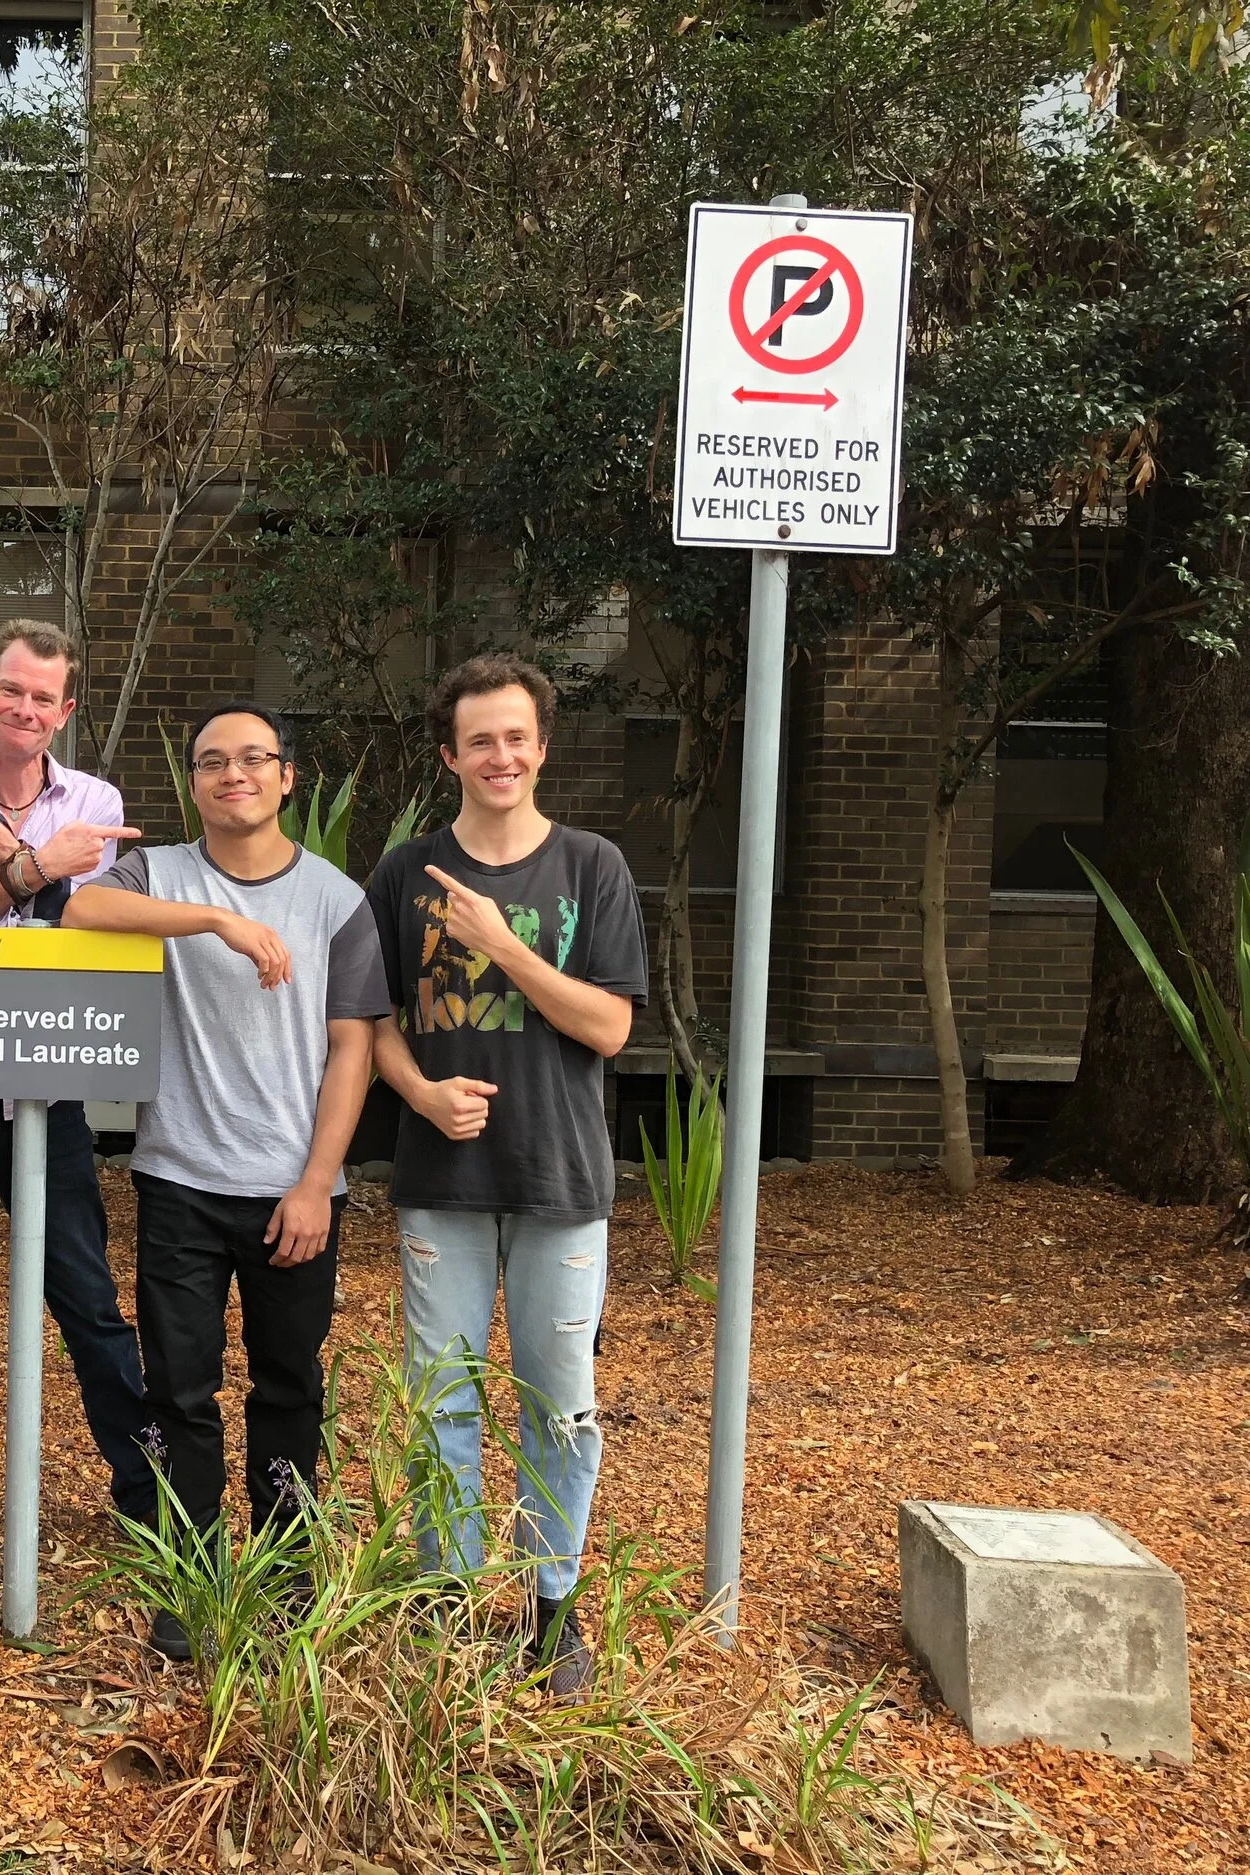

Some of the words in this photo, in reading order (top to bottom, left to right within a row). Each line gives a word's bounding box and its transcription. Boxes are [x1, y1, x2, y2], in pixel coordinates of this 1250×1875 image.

[767, 264, 834, 347] P
[697, 433, 819, 459] RESERVED
[835, 440, 879, 462] FOR
[713, 468, 861, 493] AUTHORISED
[691, 497, 805, 523] VEHICLES
[820, 503, 880, 526] ONLY
[83, 1006, 125, 1031] for
[15, 1038, 140, 1066] Laureate
